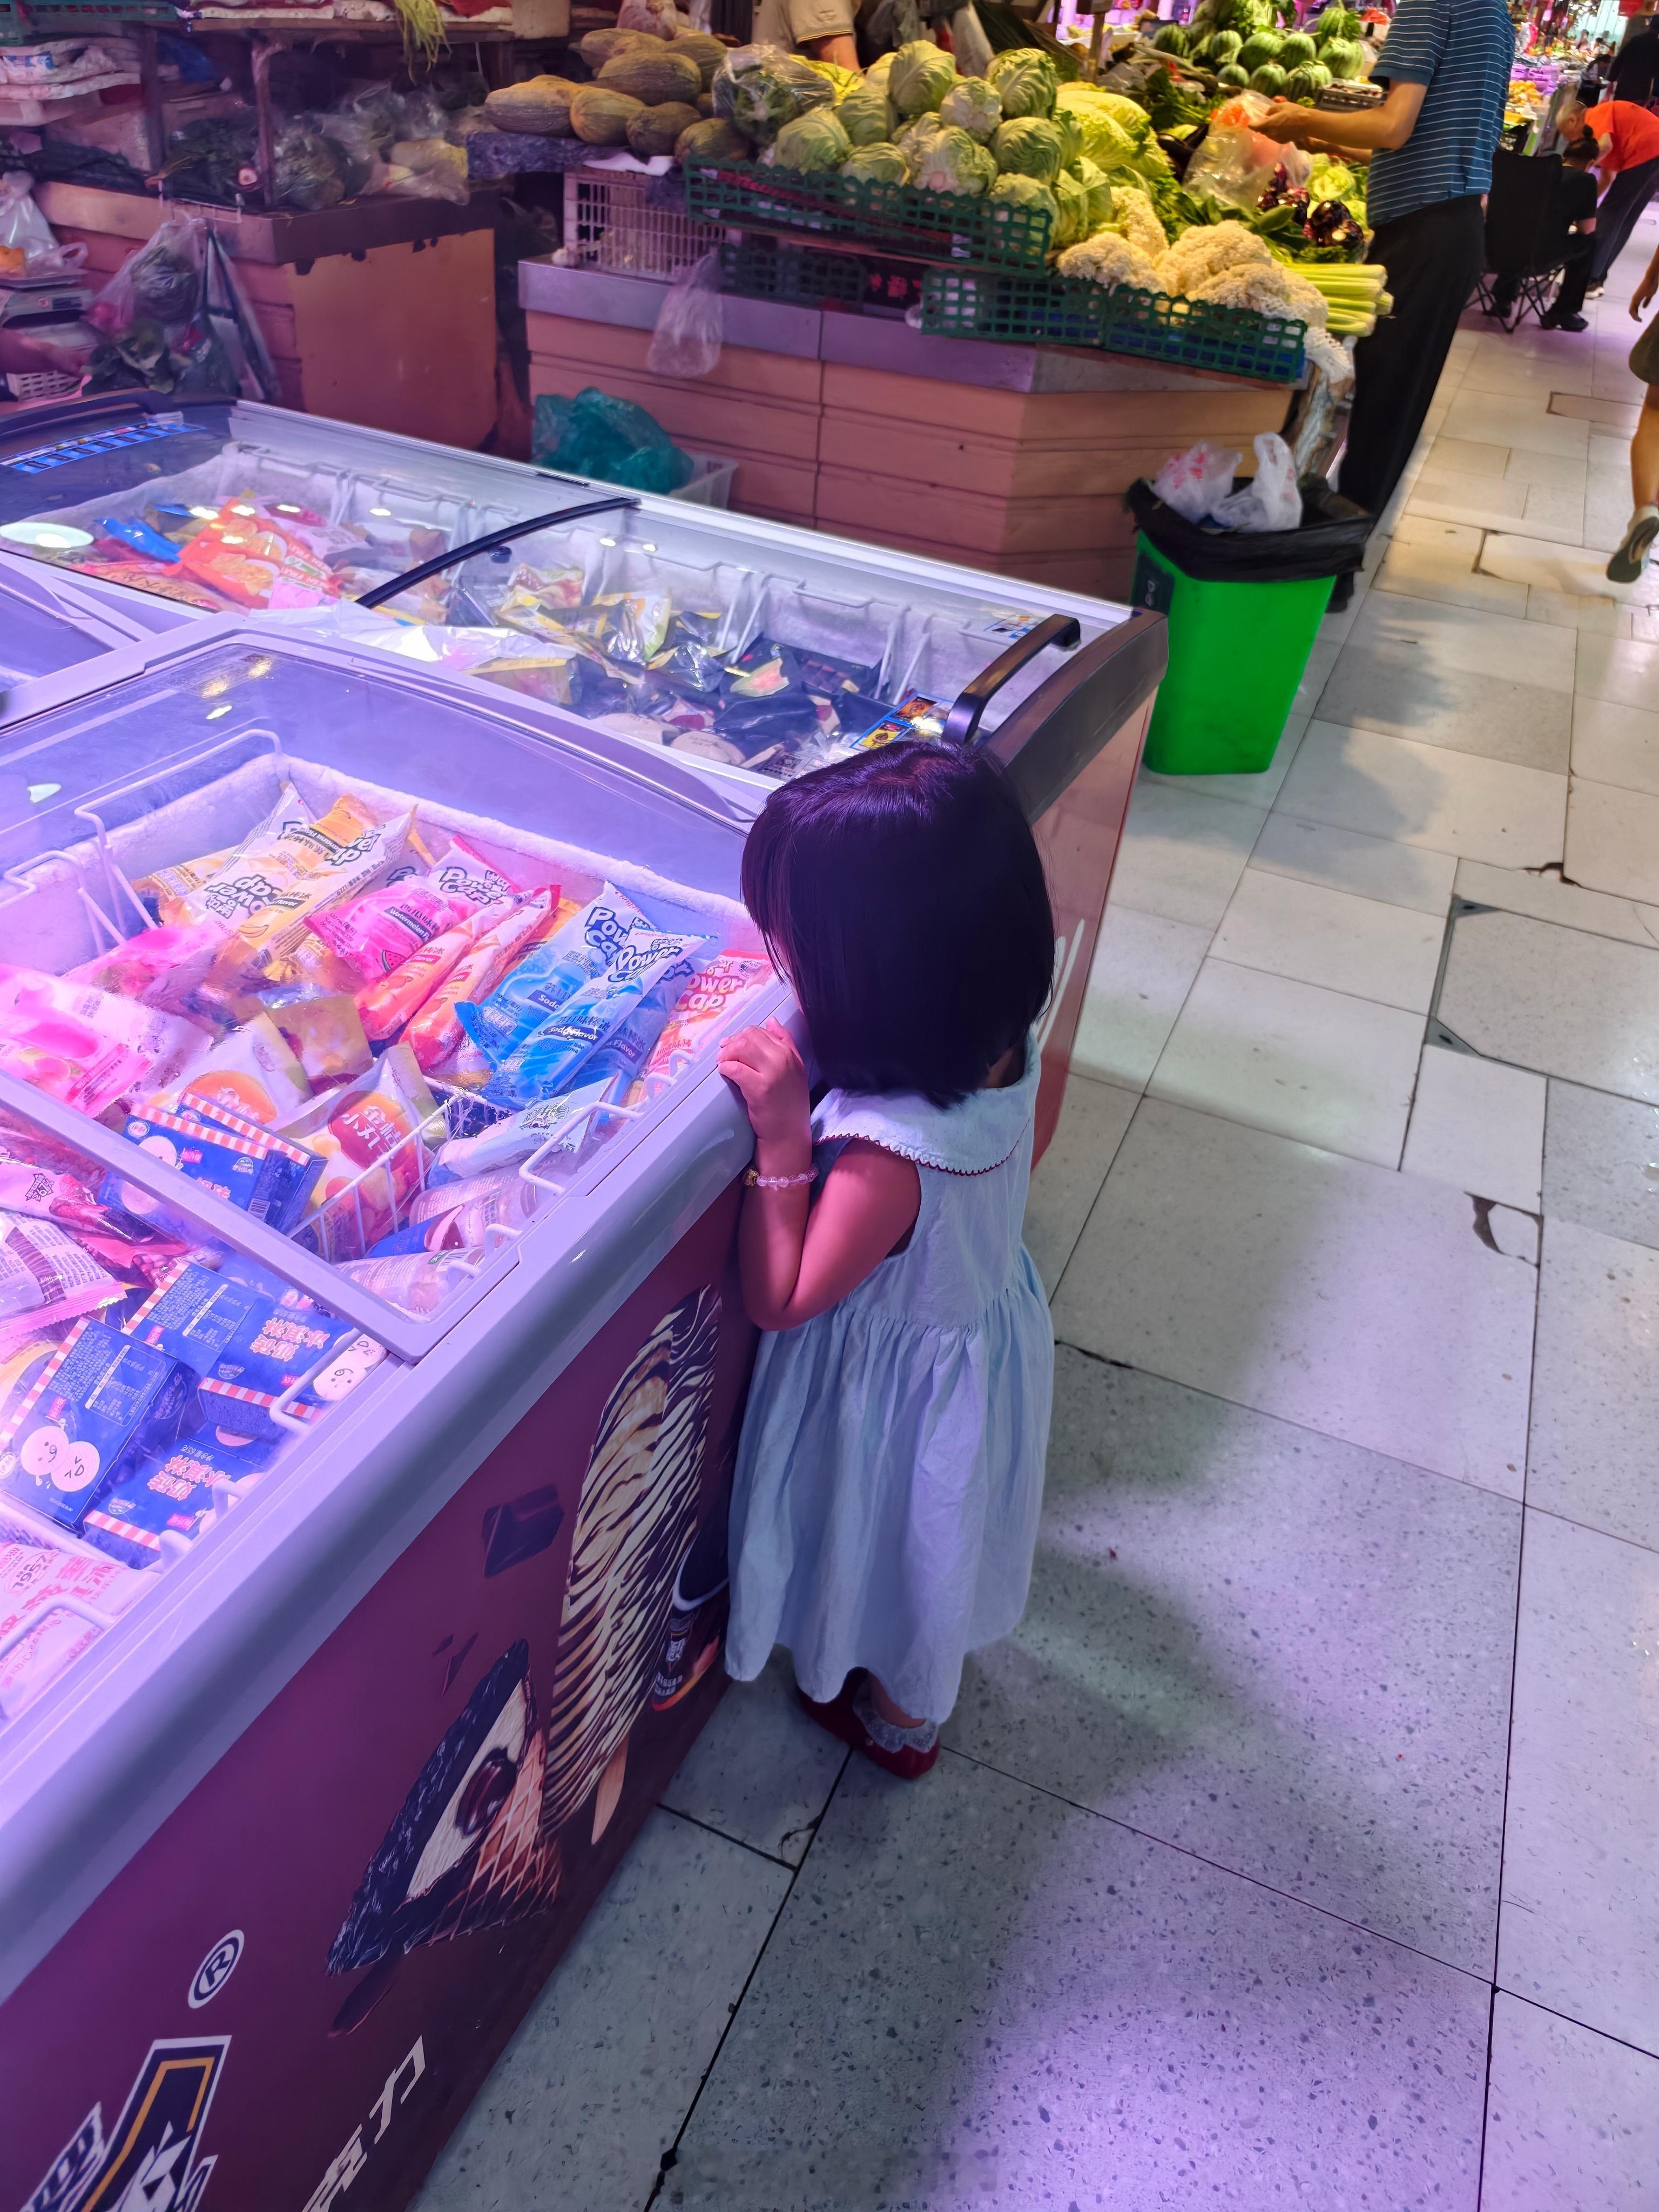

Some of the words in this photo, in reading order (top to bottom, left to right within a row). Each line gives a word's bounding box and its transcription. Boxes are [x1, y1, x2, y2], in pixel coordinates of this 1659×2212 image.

[390, 908, 424, 935] Watermelon
[584, 906, 630, 947] Pow
[615, 946, 682, 970] Power
[613, 1038, 636, 1058] Flavor
[341, 1112, 381, 1150] 小丸
[248, 1332, 298, 1361] 奶砖
[261, 1314, 330, 1351] 冰淇淋
[145, 1469, 197, 1504] 奶砖
[12, 1554, 46, 1587] 1957
